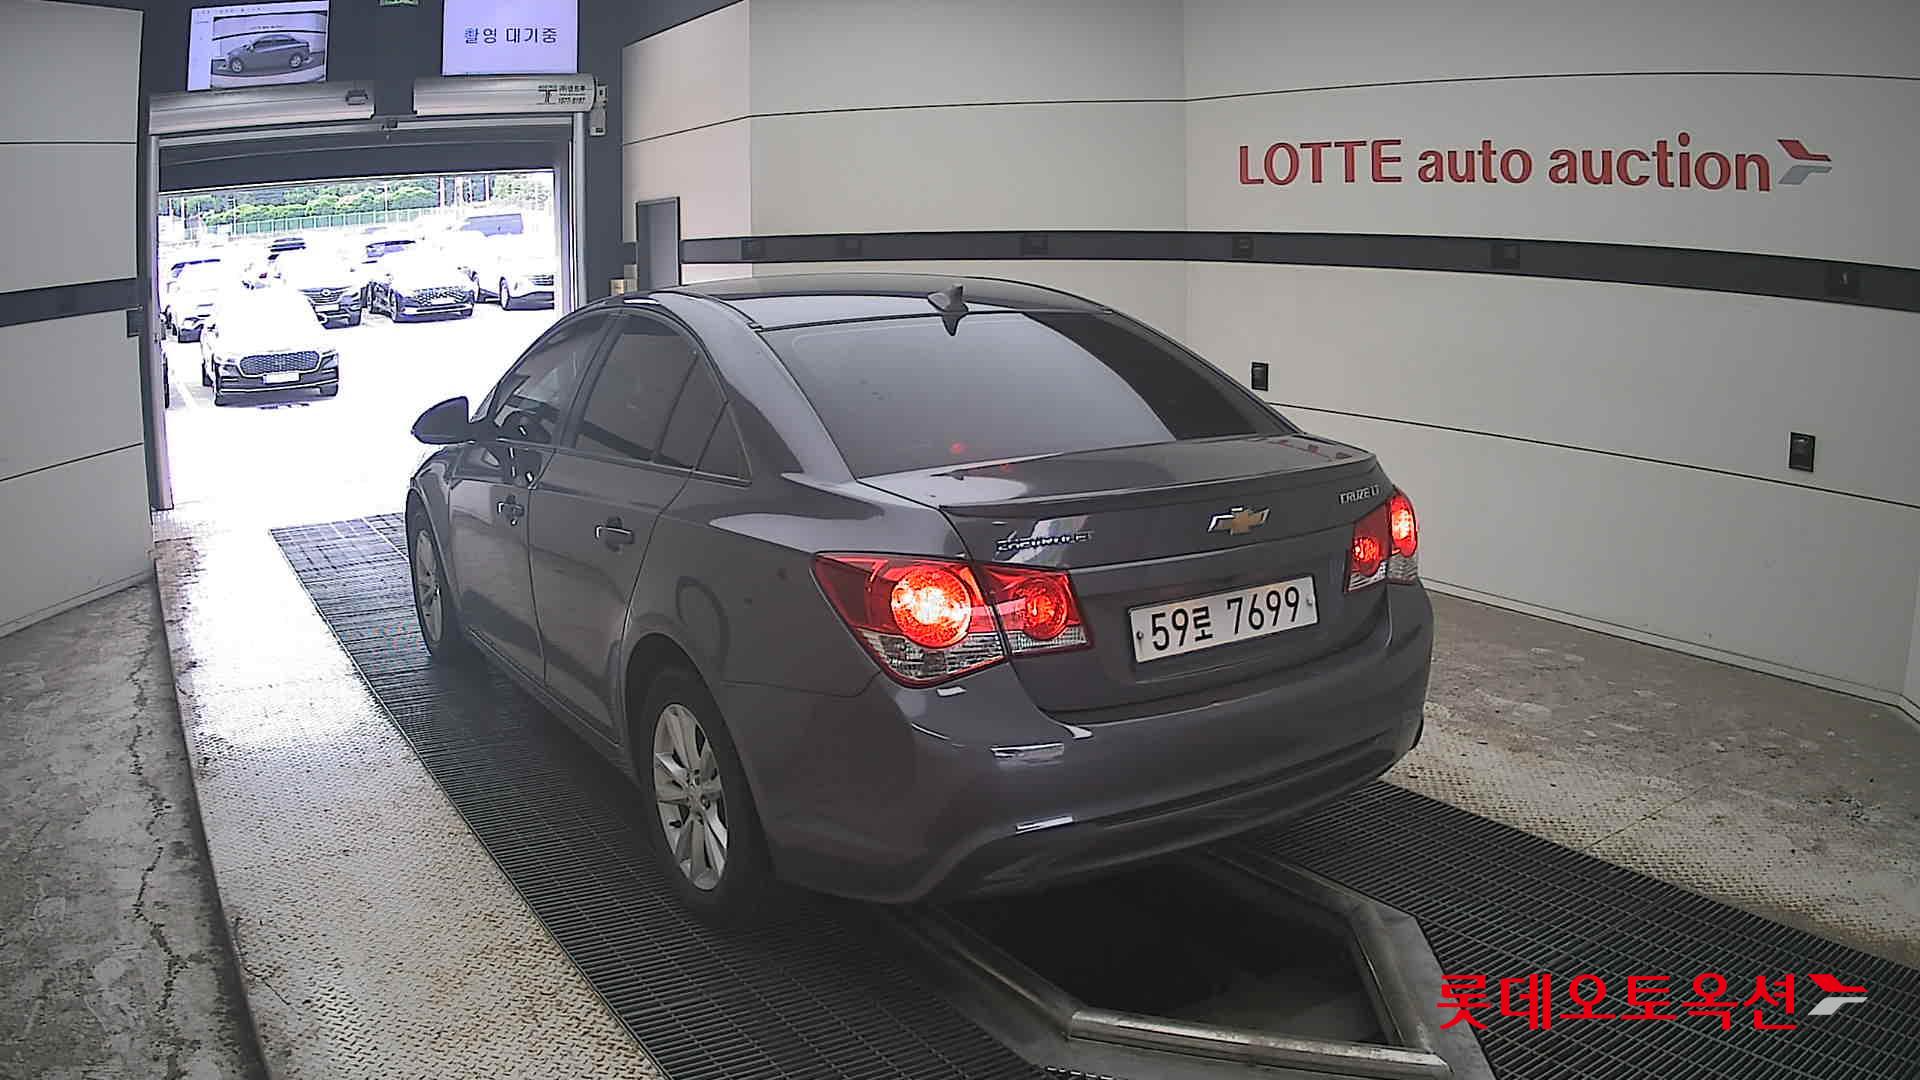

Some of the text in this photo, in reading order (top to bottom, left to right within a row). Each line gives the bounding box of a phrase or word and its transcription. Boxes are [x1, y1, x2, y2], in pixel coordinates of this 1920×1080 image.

[505, 27, 557, 44] 대기중
[1239, 131, 1771, 191] LOTTE auto auction
[1151, 586, 1300, 651] 59로 7699
